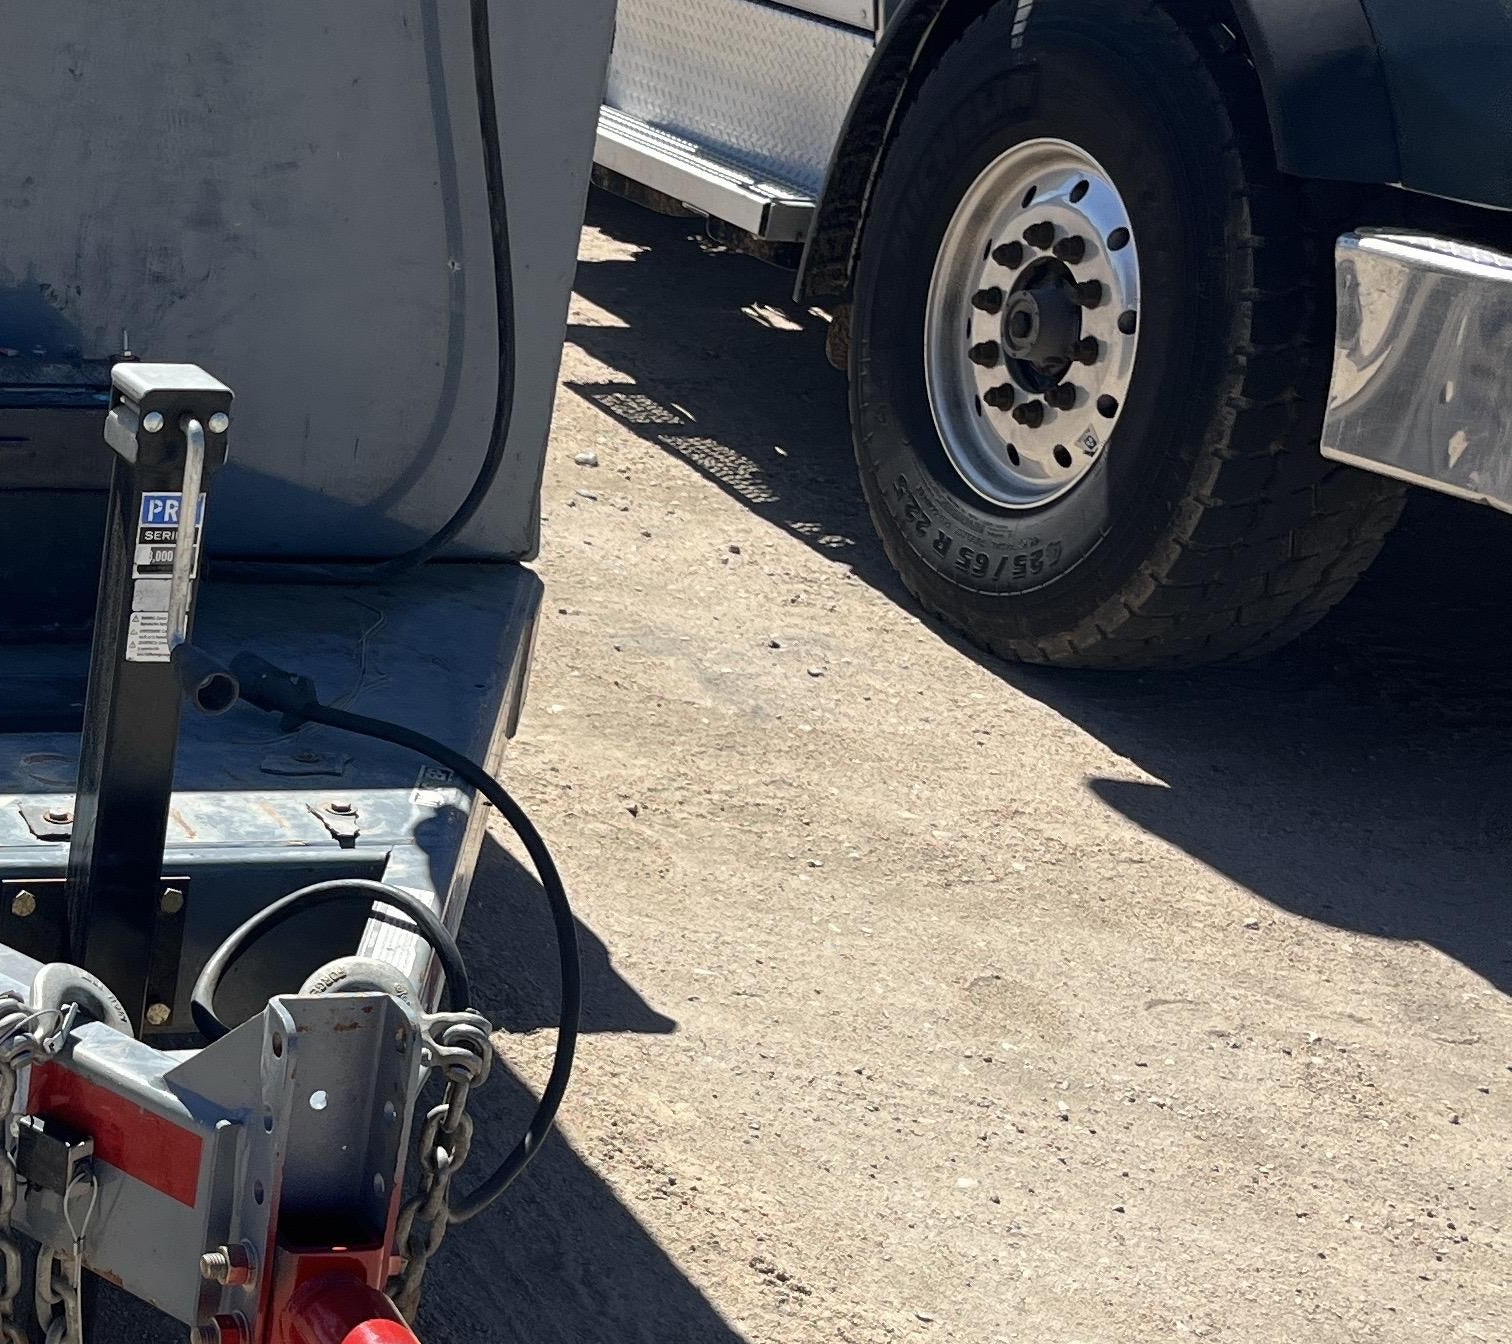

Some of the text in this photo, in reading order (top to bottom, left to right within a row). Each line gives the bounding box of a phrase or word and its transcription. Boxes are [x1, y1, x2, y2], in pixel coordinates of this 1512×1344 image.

[148, 499, 180, 522] PR
[144, 530, 178, 540] SERI
[148, 550, 173, 563] ,000
